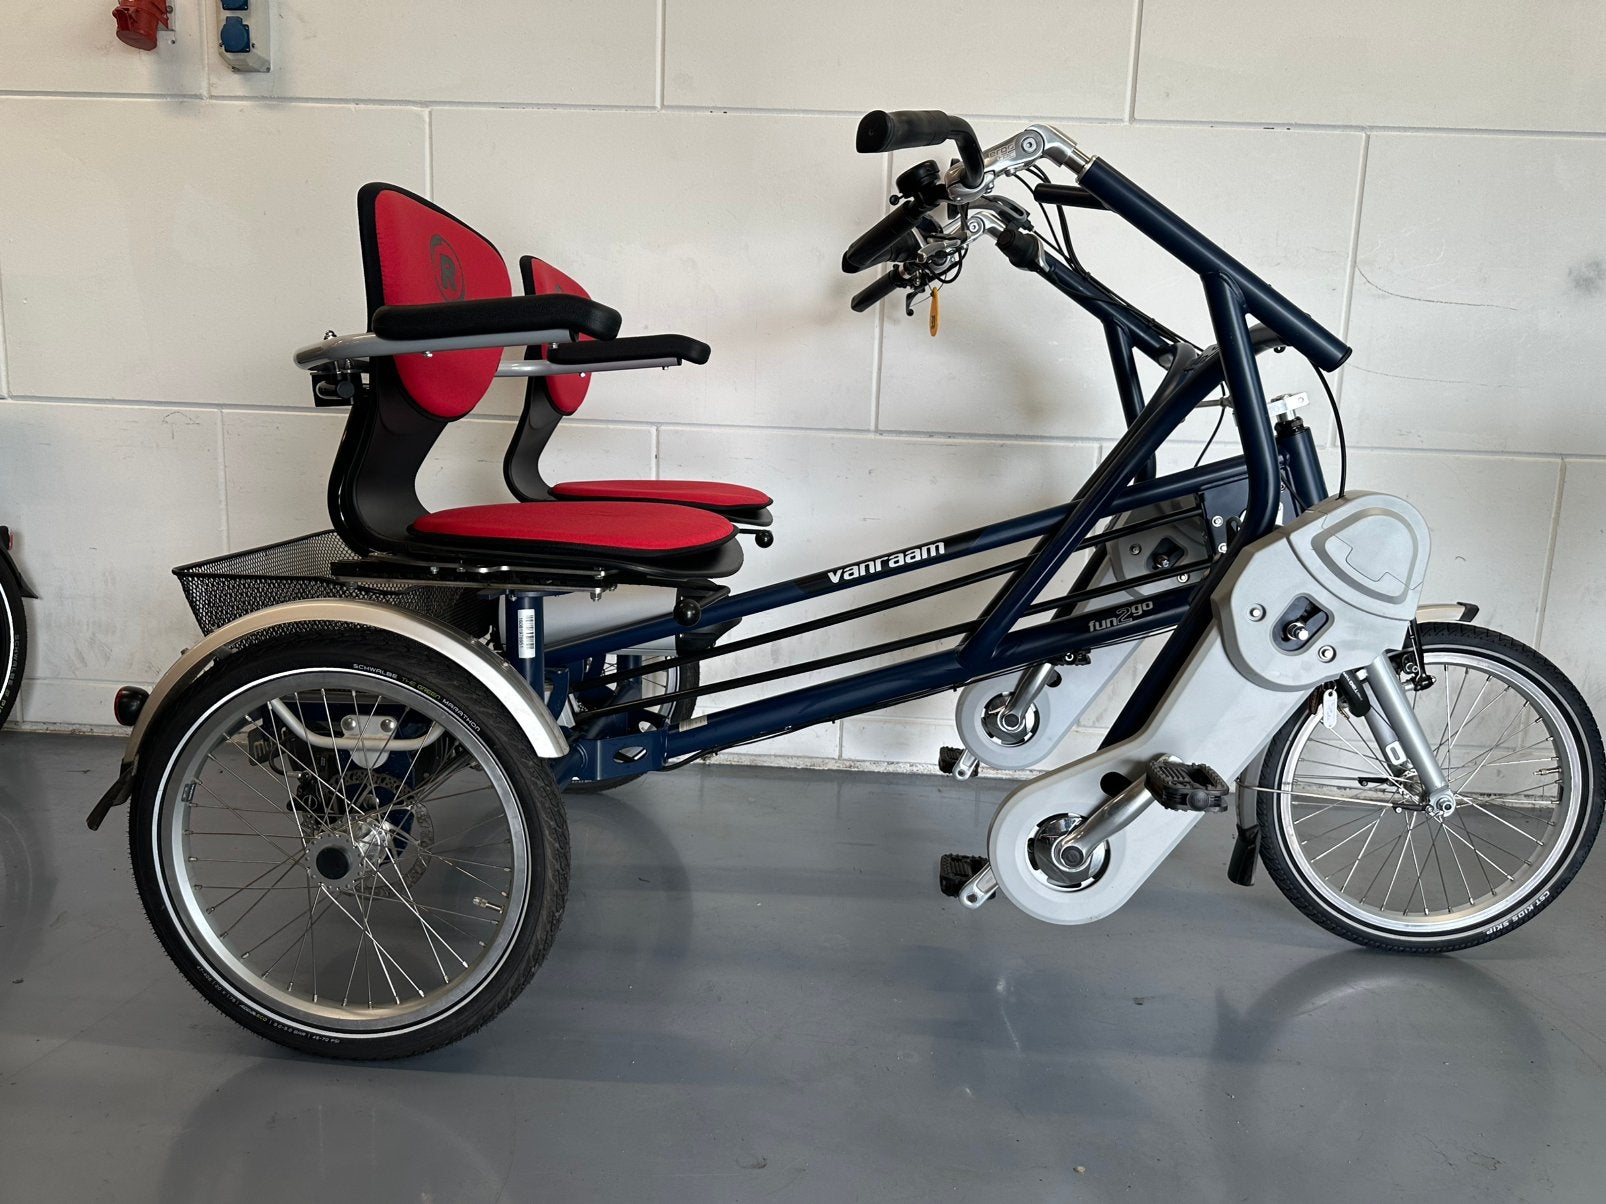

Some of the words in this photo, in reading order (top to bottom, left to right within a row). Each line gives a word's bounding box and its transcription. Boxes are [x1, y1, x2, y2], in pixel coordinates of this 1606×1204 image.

[827, 541, 945, 584] vanraam
[1088, 600, 1154, 633] fun2go
[352, 663, 398, 679] SCHWALBE
[442, 698, 481, 732] MARATHON
[1535, 890, 1550, 906] CST
[1511, 905, 1535, 923] KIDS
[1486, 921, 1510, 936] SKIP
